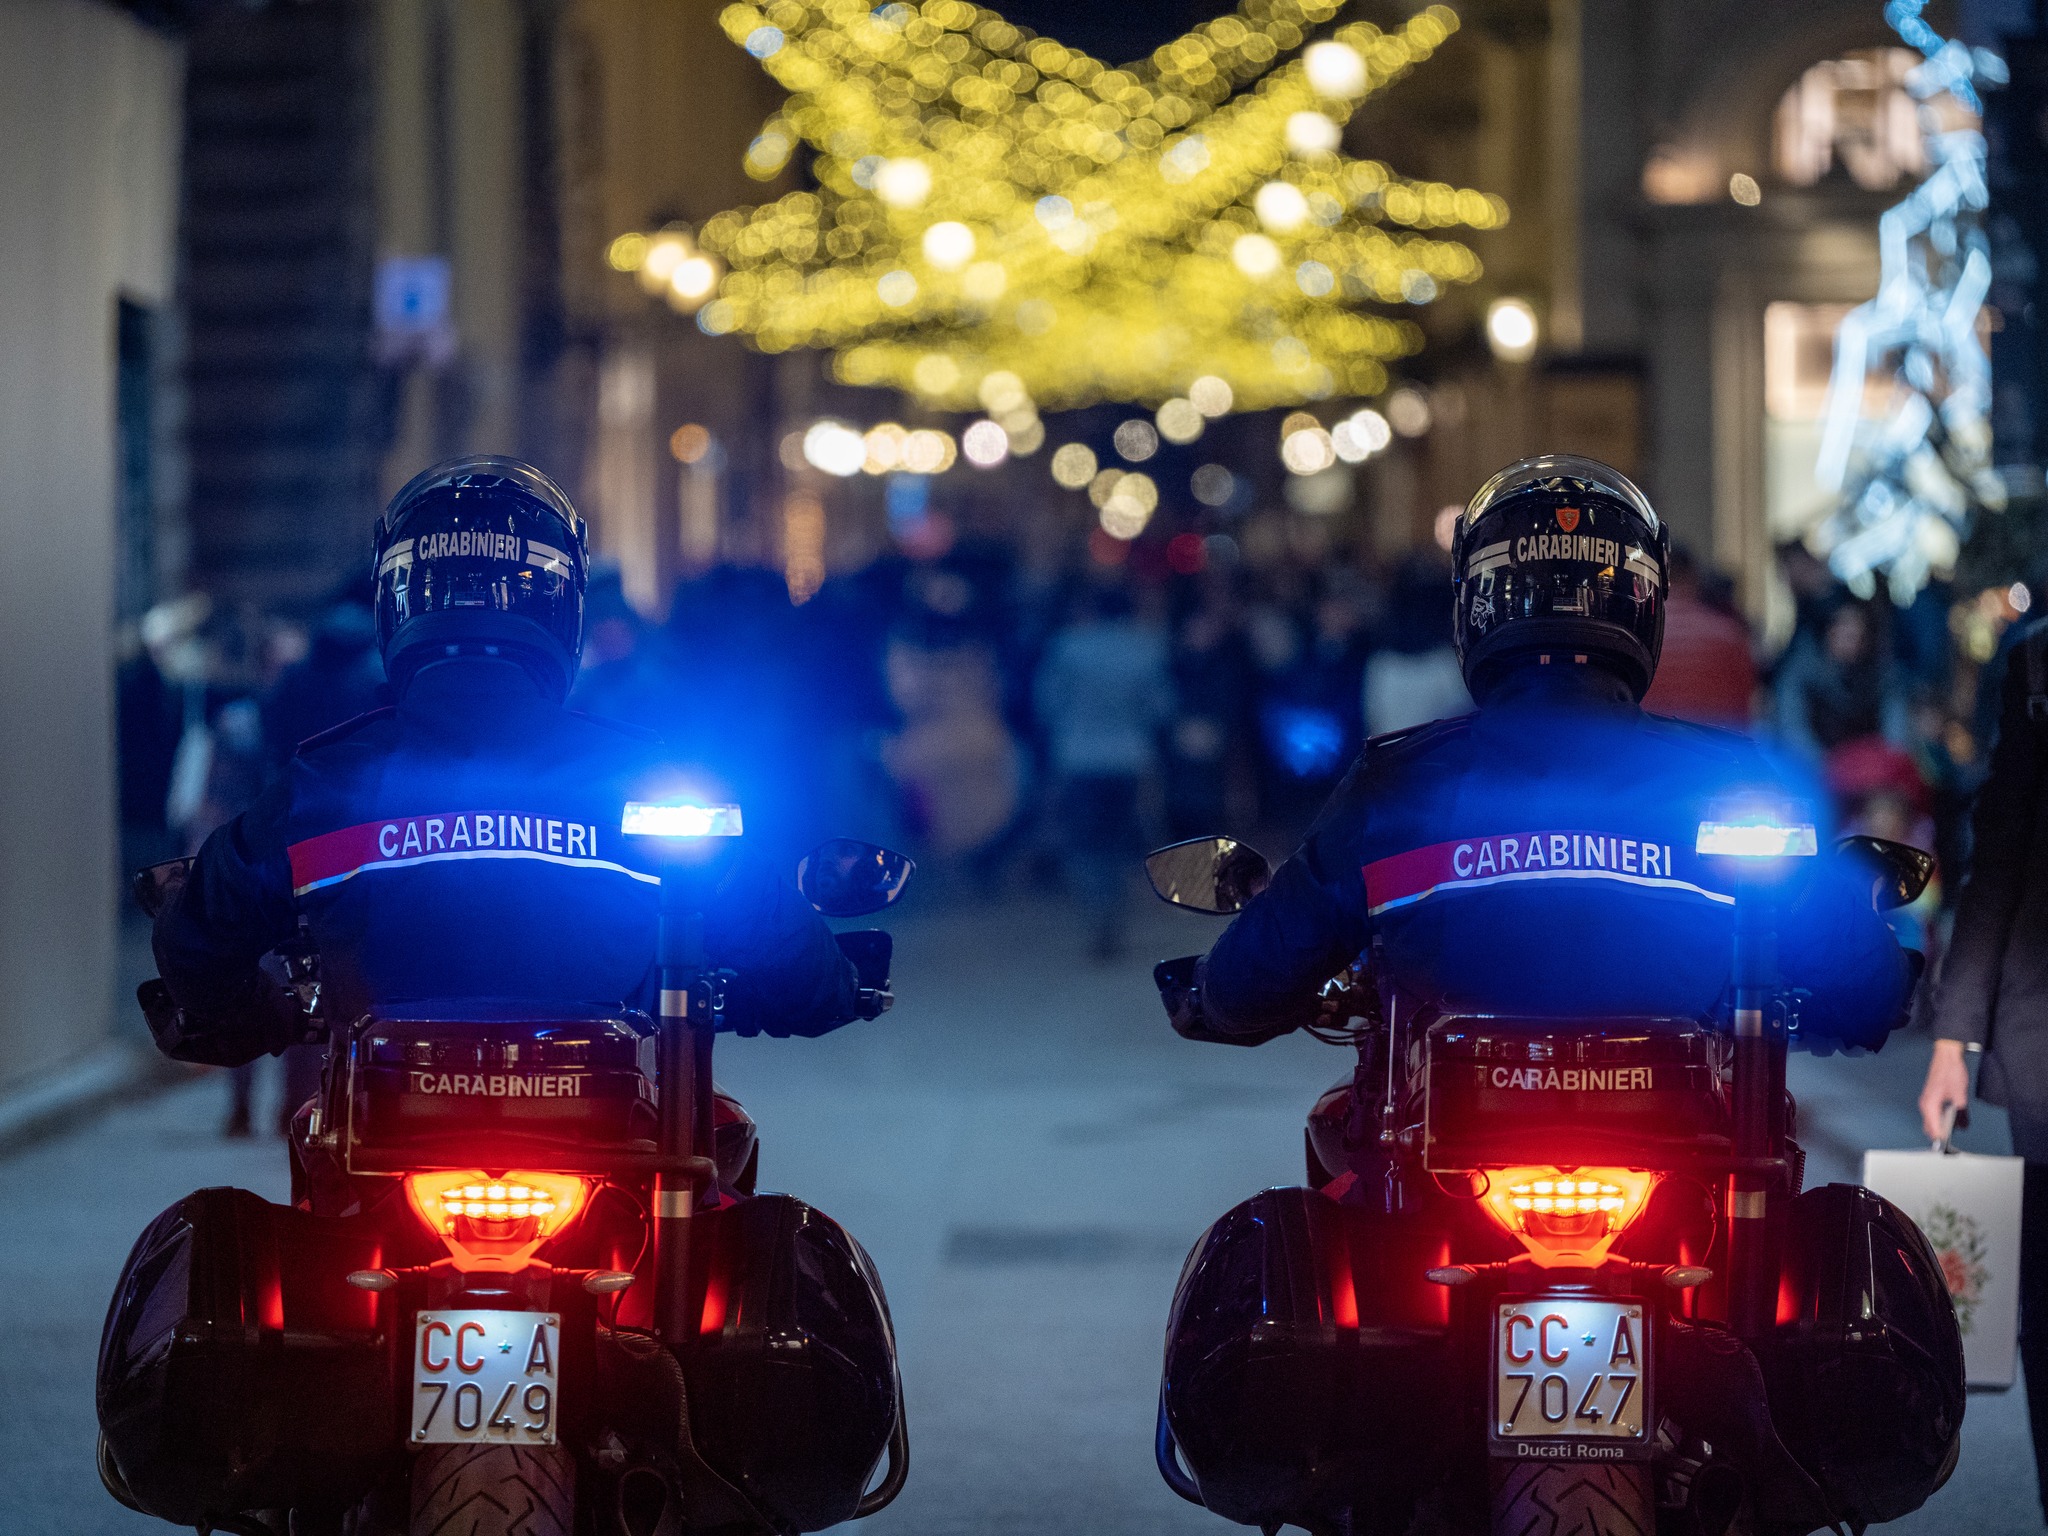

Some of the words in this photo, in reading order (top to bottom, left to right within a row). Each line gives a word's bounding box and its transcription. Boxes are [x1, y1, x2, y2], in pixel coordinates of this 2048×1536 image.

[418, 531, 521, 562] CARABINIERI
[1516, 534, 1619, 567] CARABINIERI
[378, 815, 598, 858] CARABINIERI
[1453, 834, 1672, 877] CARABINIERI
[419, 1073, 581, 1097] CARABINIERI
[1491, 1067, 1653, 1091] CARABINIERI
[422, 1321, 486, 1373] CC
[523, 1323, 552, 1375] A
[1506, 1314, 1569, 1363] CC
[1608, 1314, 1636, 1366] A
[420, 1381, 551, 1433] 7049
[1506, 1372, 1638, 1426] 7047
[1517, 1443, 1571, 1458] Ducati
[1577, 1444, 1625, 1458] Roma
